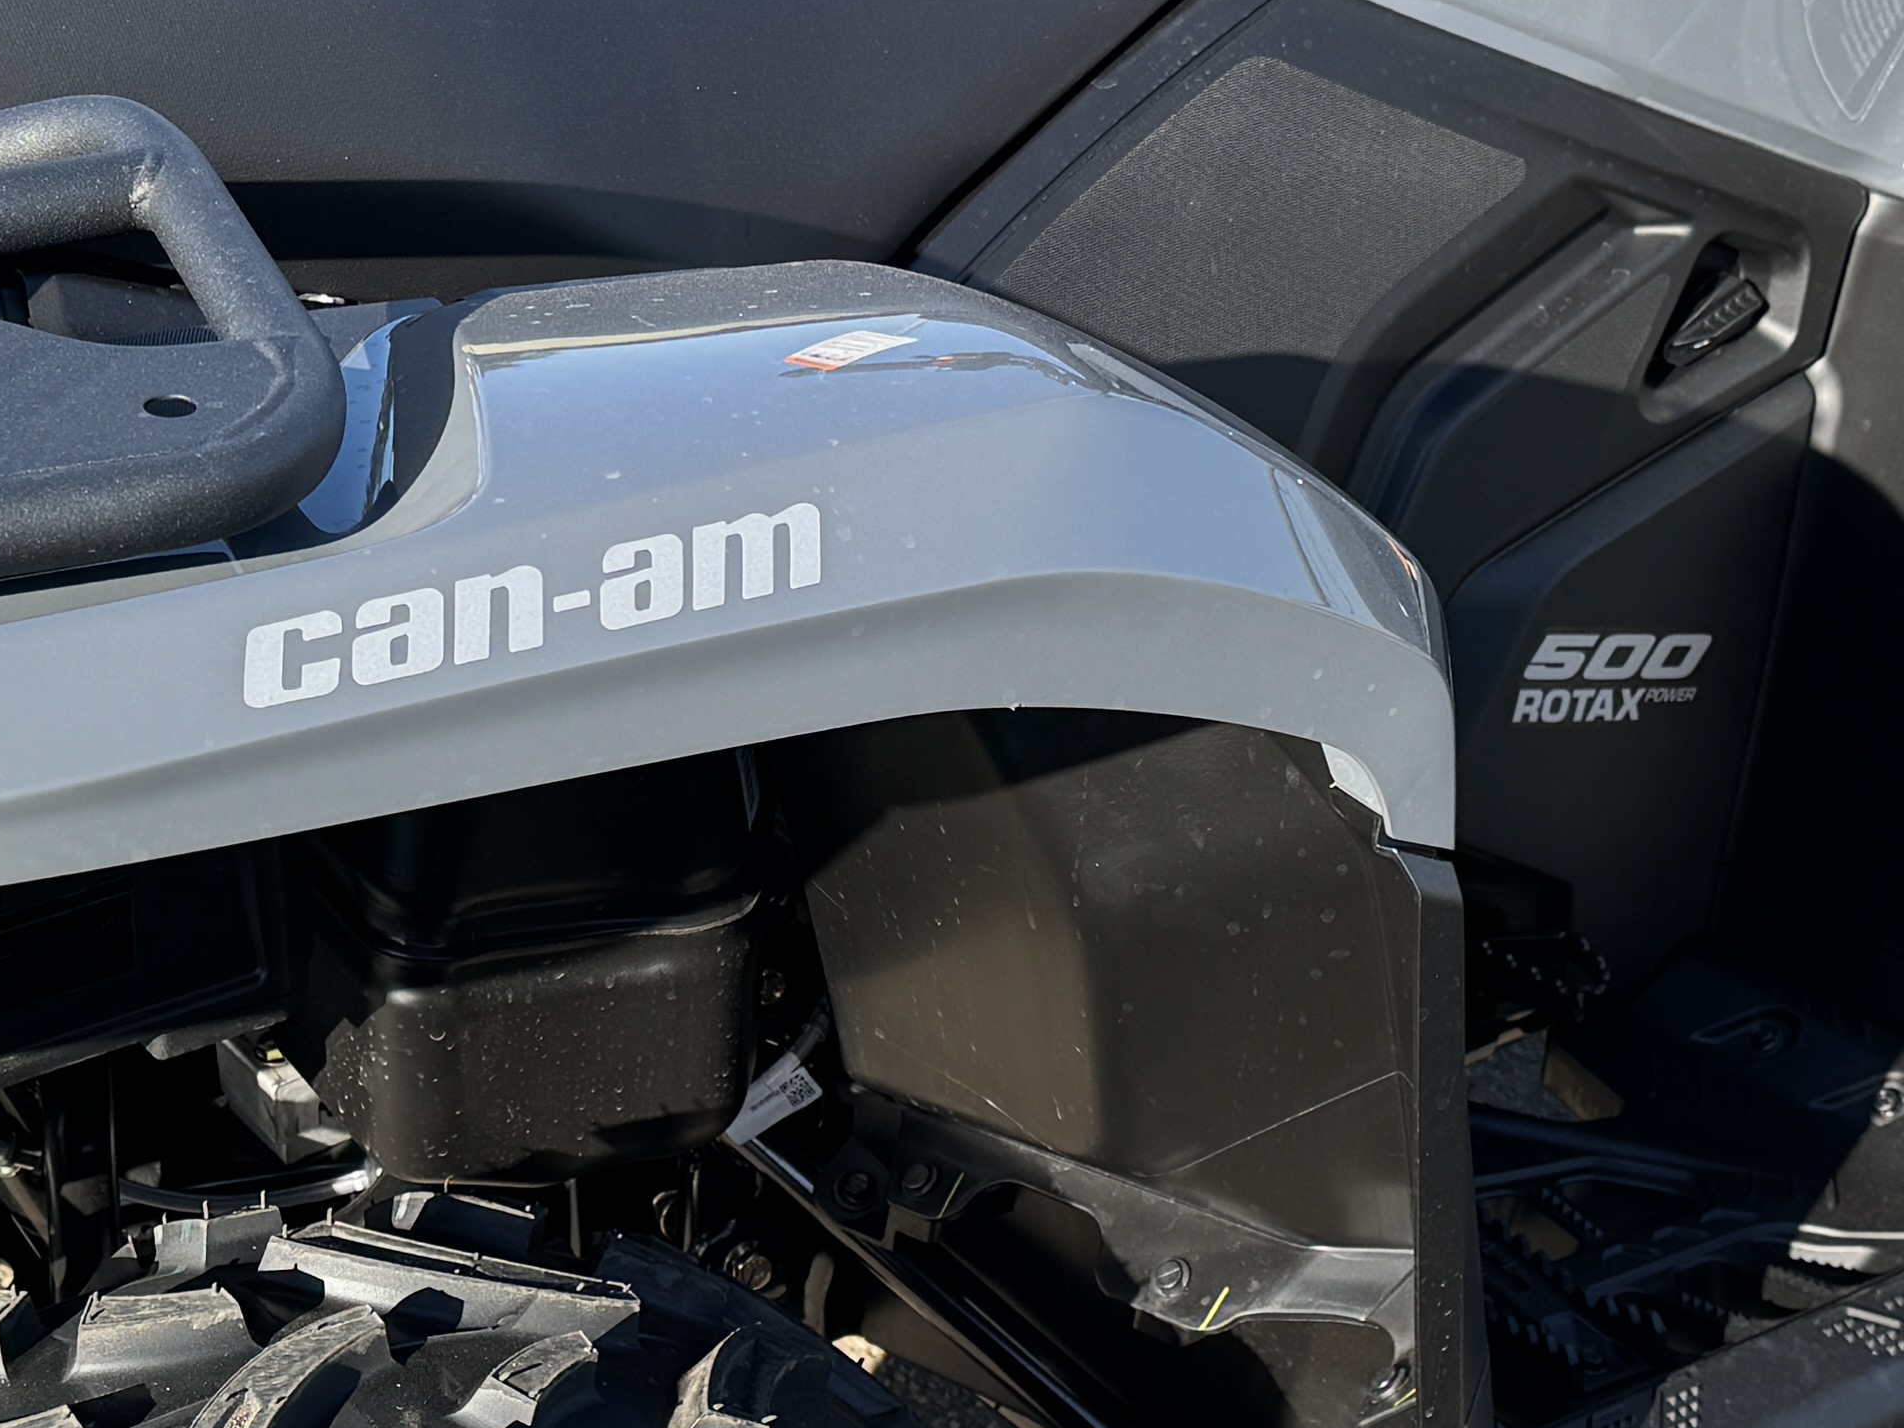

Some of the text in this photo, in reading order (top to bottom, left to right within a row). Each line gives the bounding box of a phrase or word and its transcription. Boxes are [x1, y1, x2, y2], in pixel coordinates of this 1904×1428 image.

[243, 502, 822, 708] can-am
[1523, 633, 1713, 681] 500
[1512, 686, 1697, 724] ROTAX POWER
